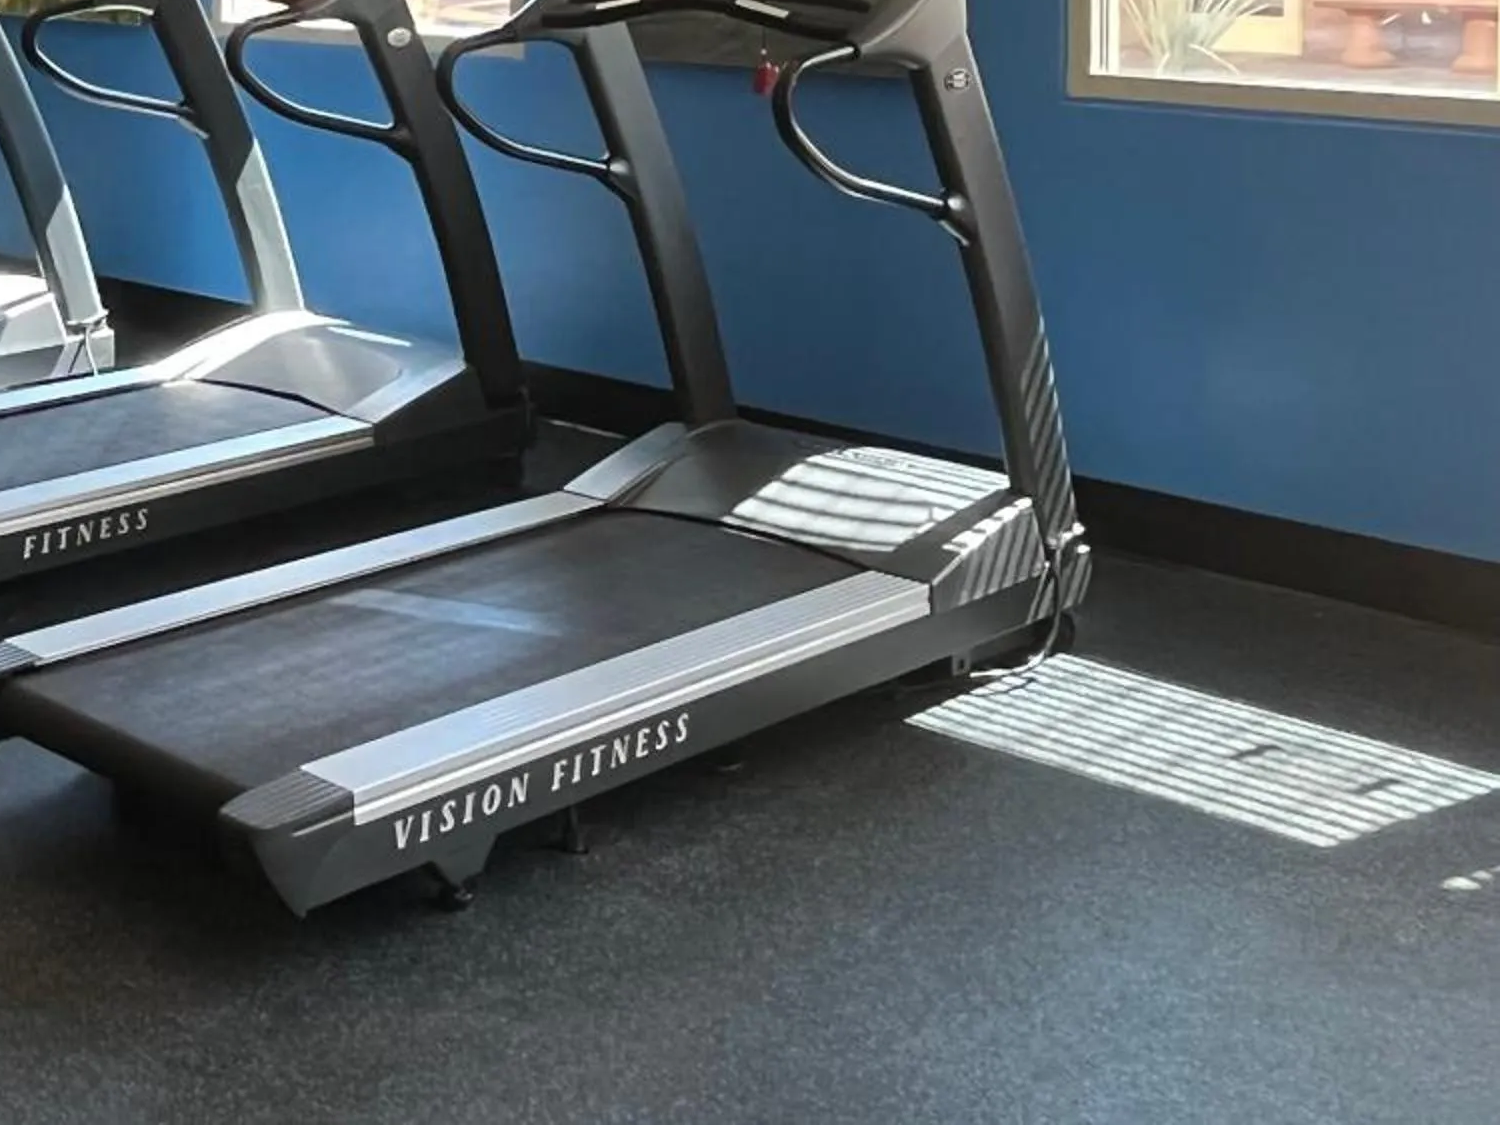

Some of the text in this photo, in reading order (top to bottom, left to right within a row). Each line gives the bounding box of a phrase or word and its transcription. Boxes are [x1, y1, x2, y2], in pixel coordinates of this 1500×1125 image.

[23, 508, 149, 559] FITNESS
[394, 713, 689, 849] VISION FITNESS
